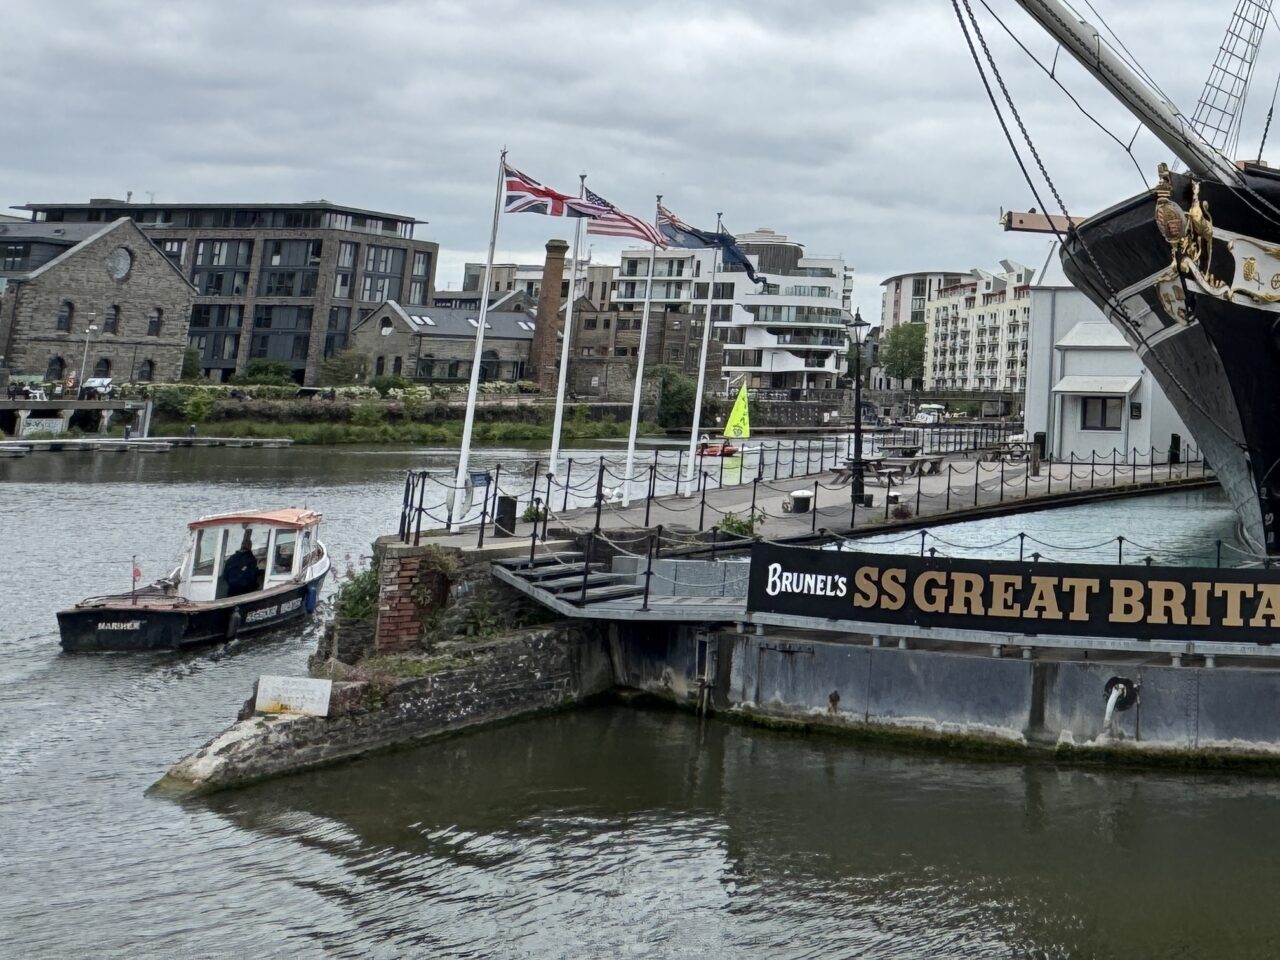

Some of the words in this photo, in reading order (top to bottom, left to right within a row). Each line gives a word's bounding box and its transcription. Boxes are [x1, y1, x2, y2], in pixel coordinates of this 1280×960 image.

[766, 563, 847, 597] BRUNEL'S
[853, 566, 907, 611] SS
[913, 570, 1100, 621] GREAT
